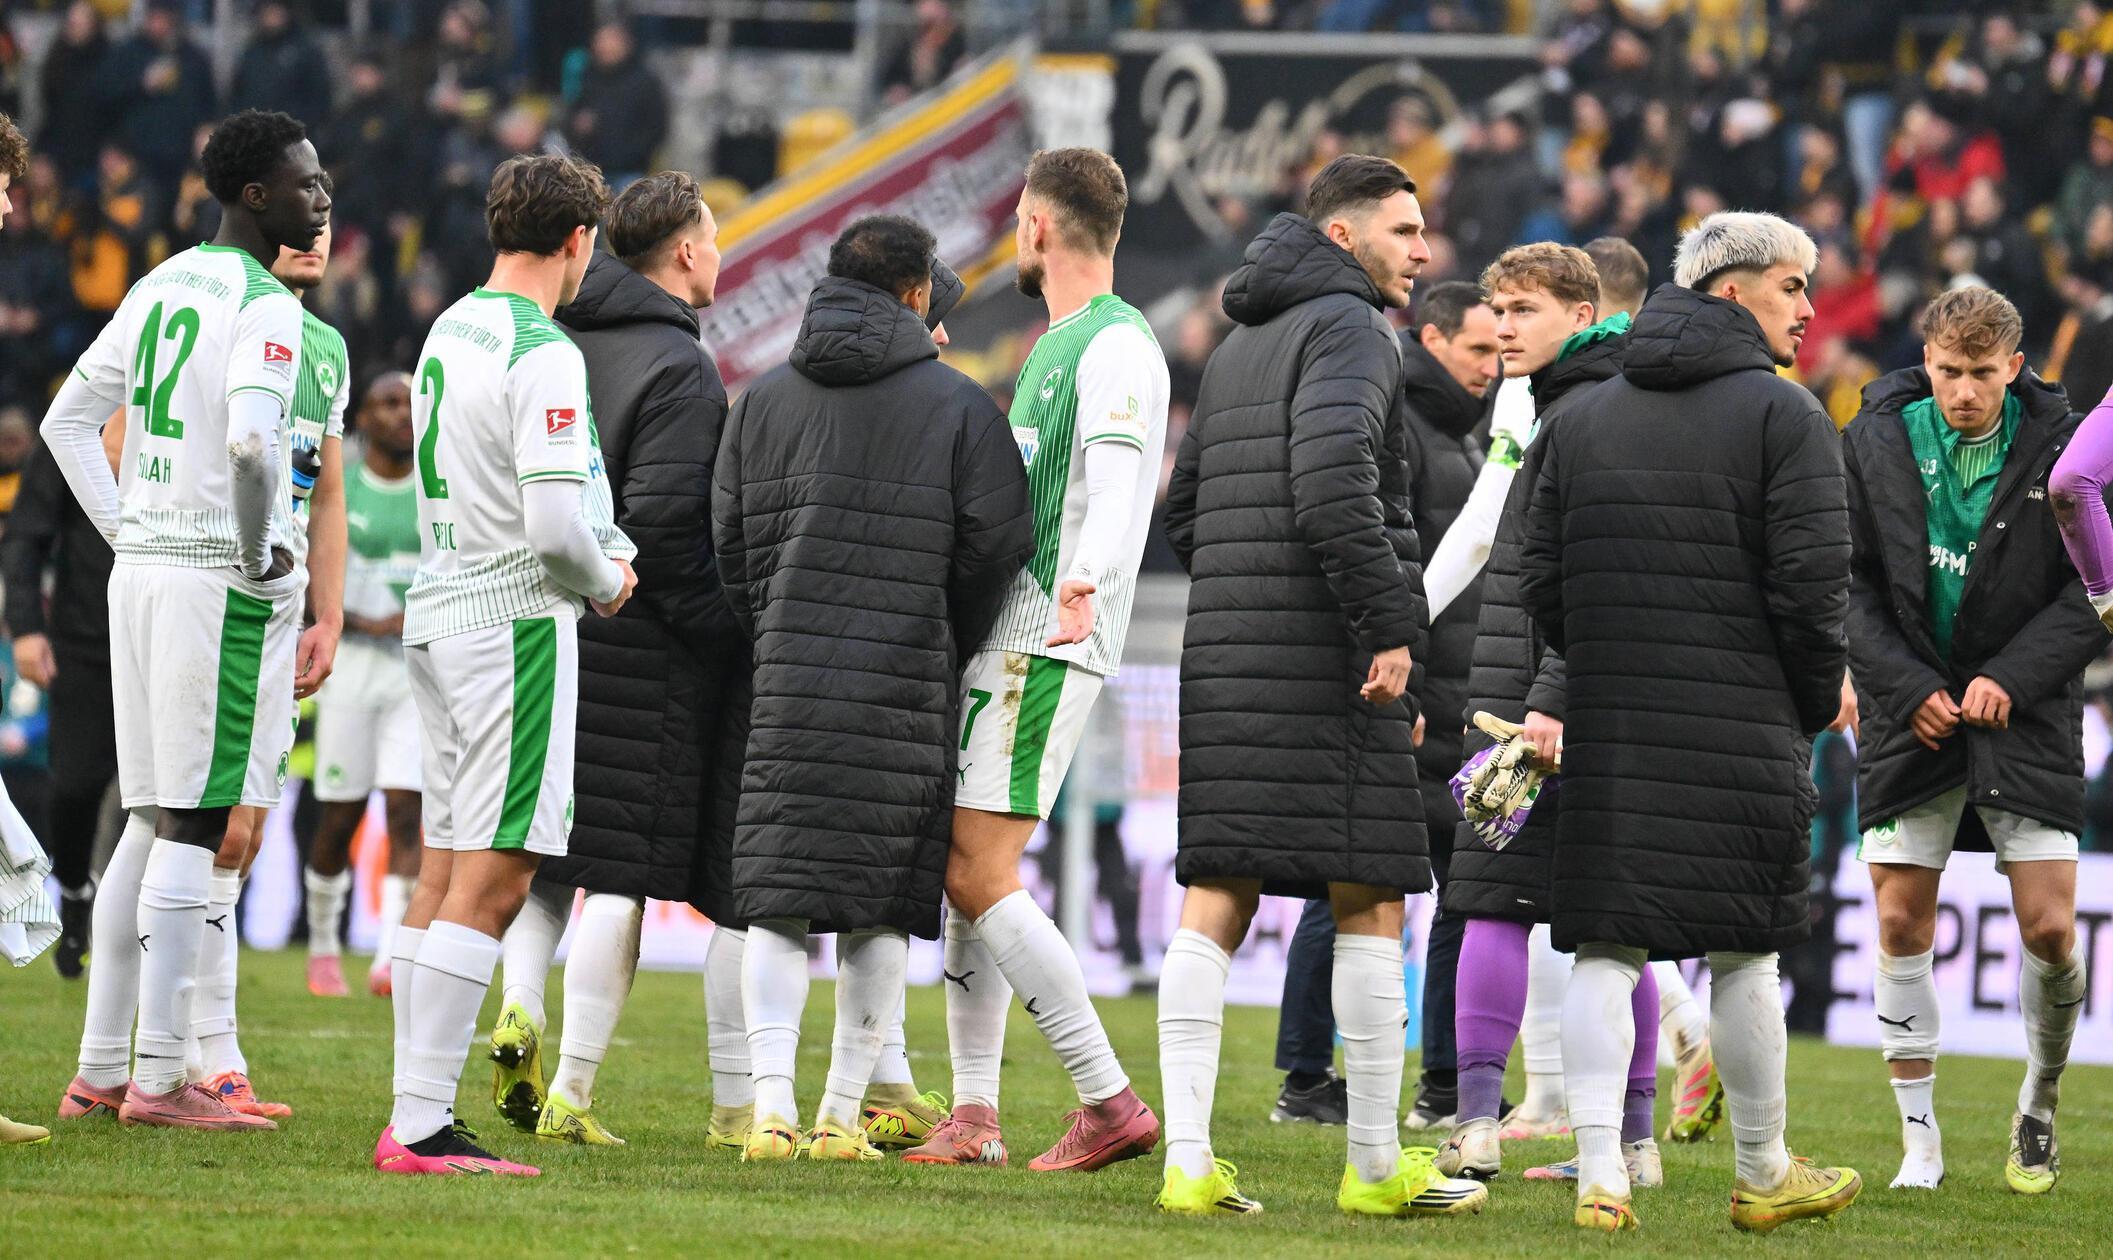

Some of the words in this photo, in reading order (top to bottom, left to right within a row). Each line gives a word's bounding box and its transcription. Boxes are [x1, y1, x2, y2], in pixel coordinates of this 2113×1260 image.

[132, 301, 200, 440] 42
[418, 357, 449, 500] 2
[959, 688, 992, 751] 7
